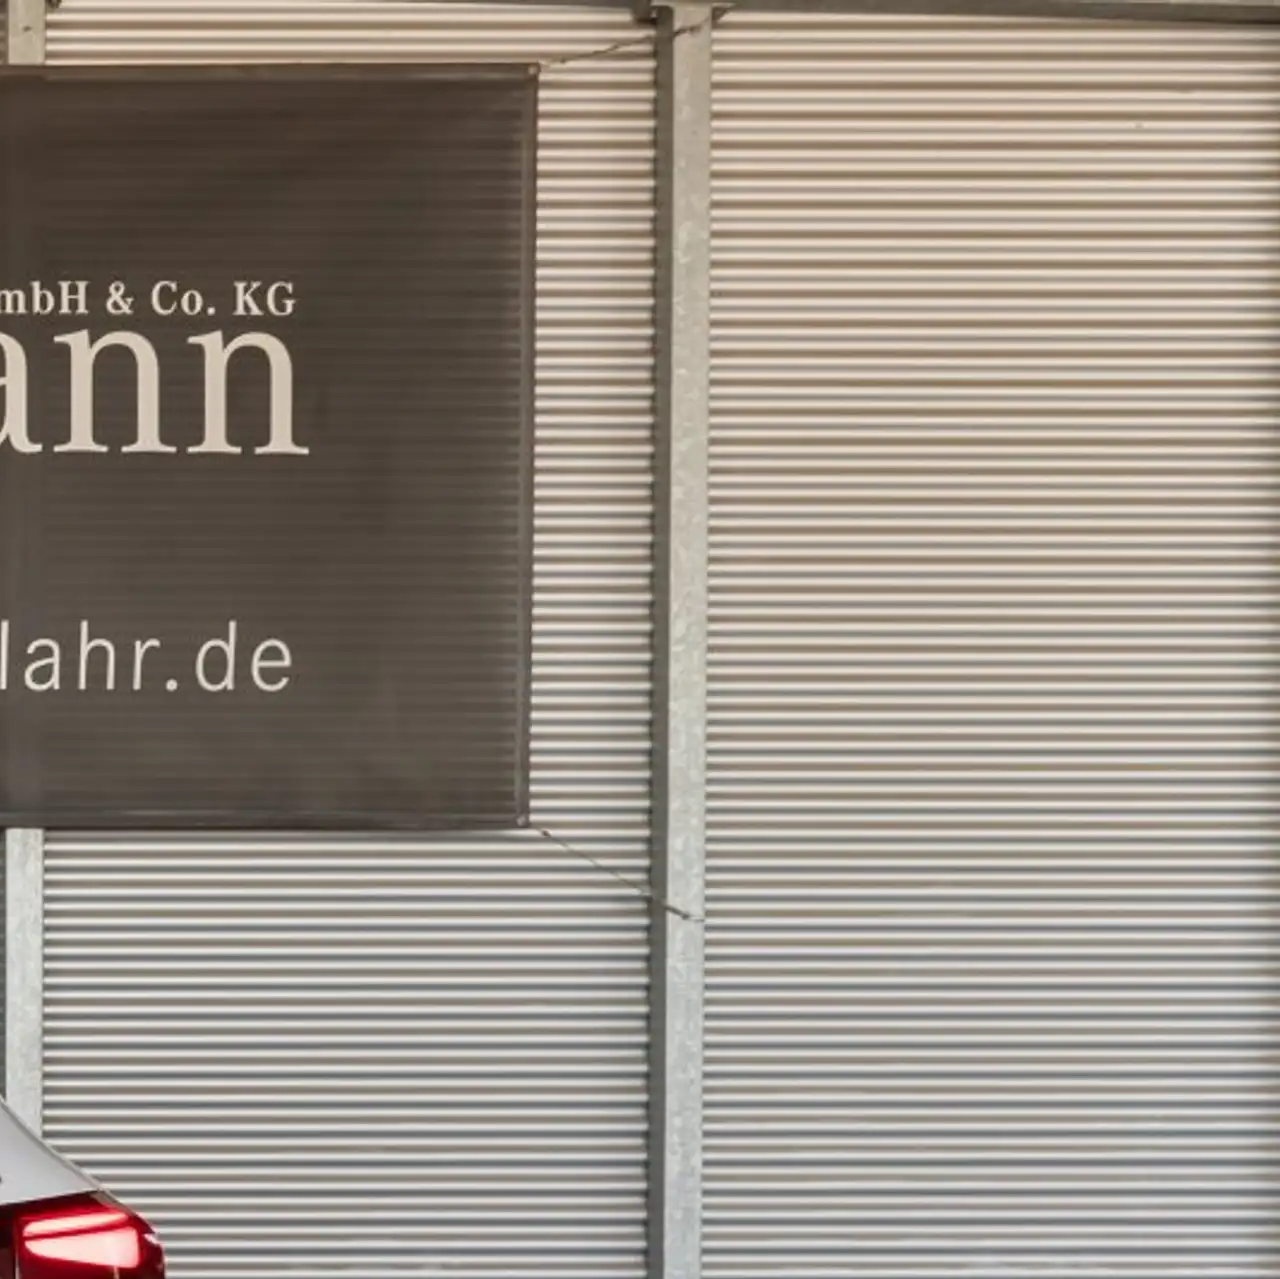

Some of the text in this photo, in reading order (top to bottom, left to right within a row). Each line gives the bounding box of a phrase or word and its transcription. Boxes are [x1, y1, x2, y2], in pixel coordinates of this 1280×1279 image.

[105, 281, 134, 316] &
[150, 281, 216, 317] Co.
[233, 282, 297, 318] KG
